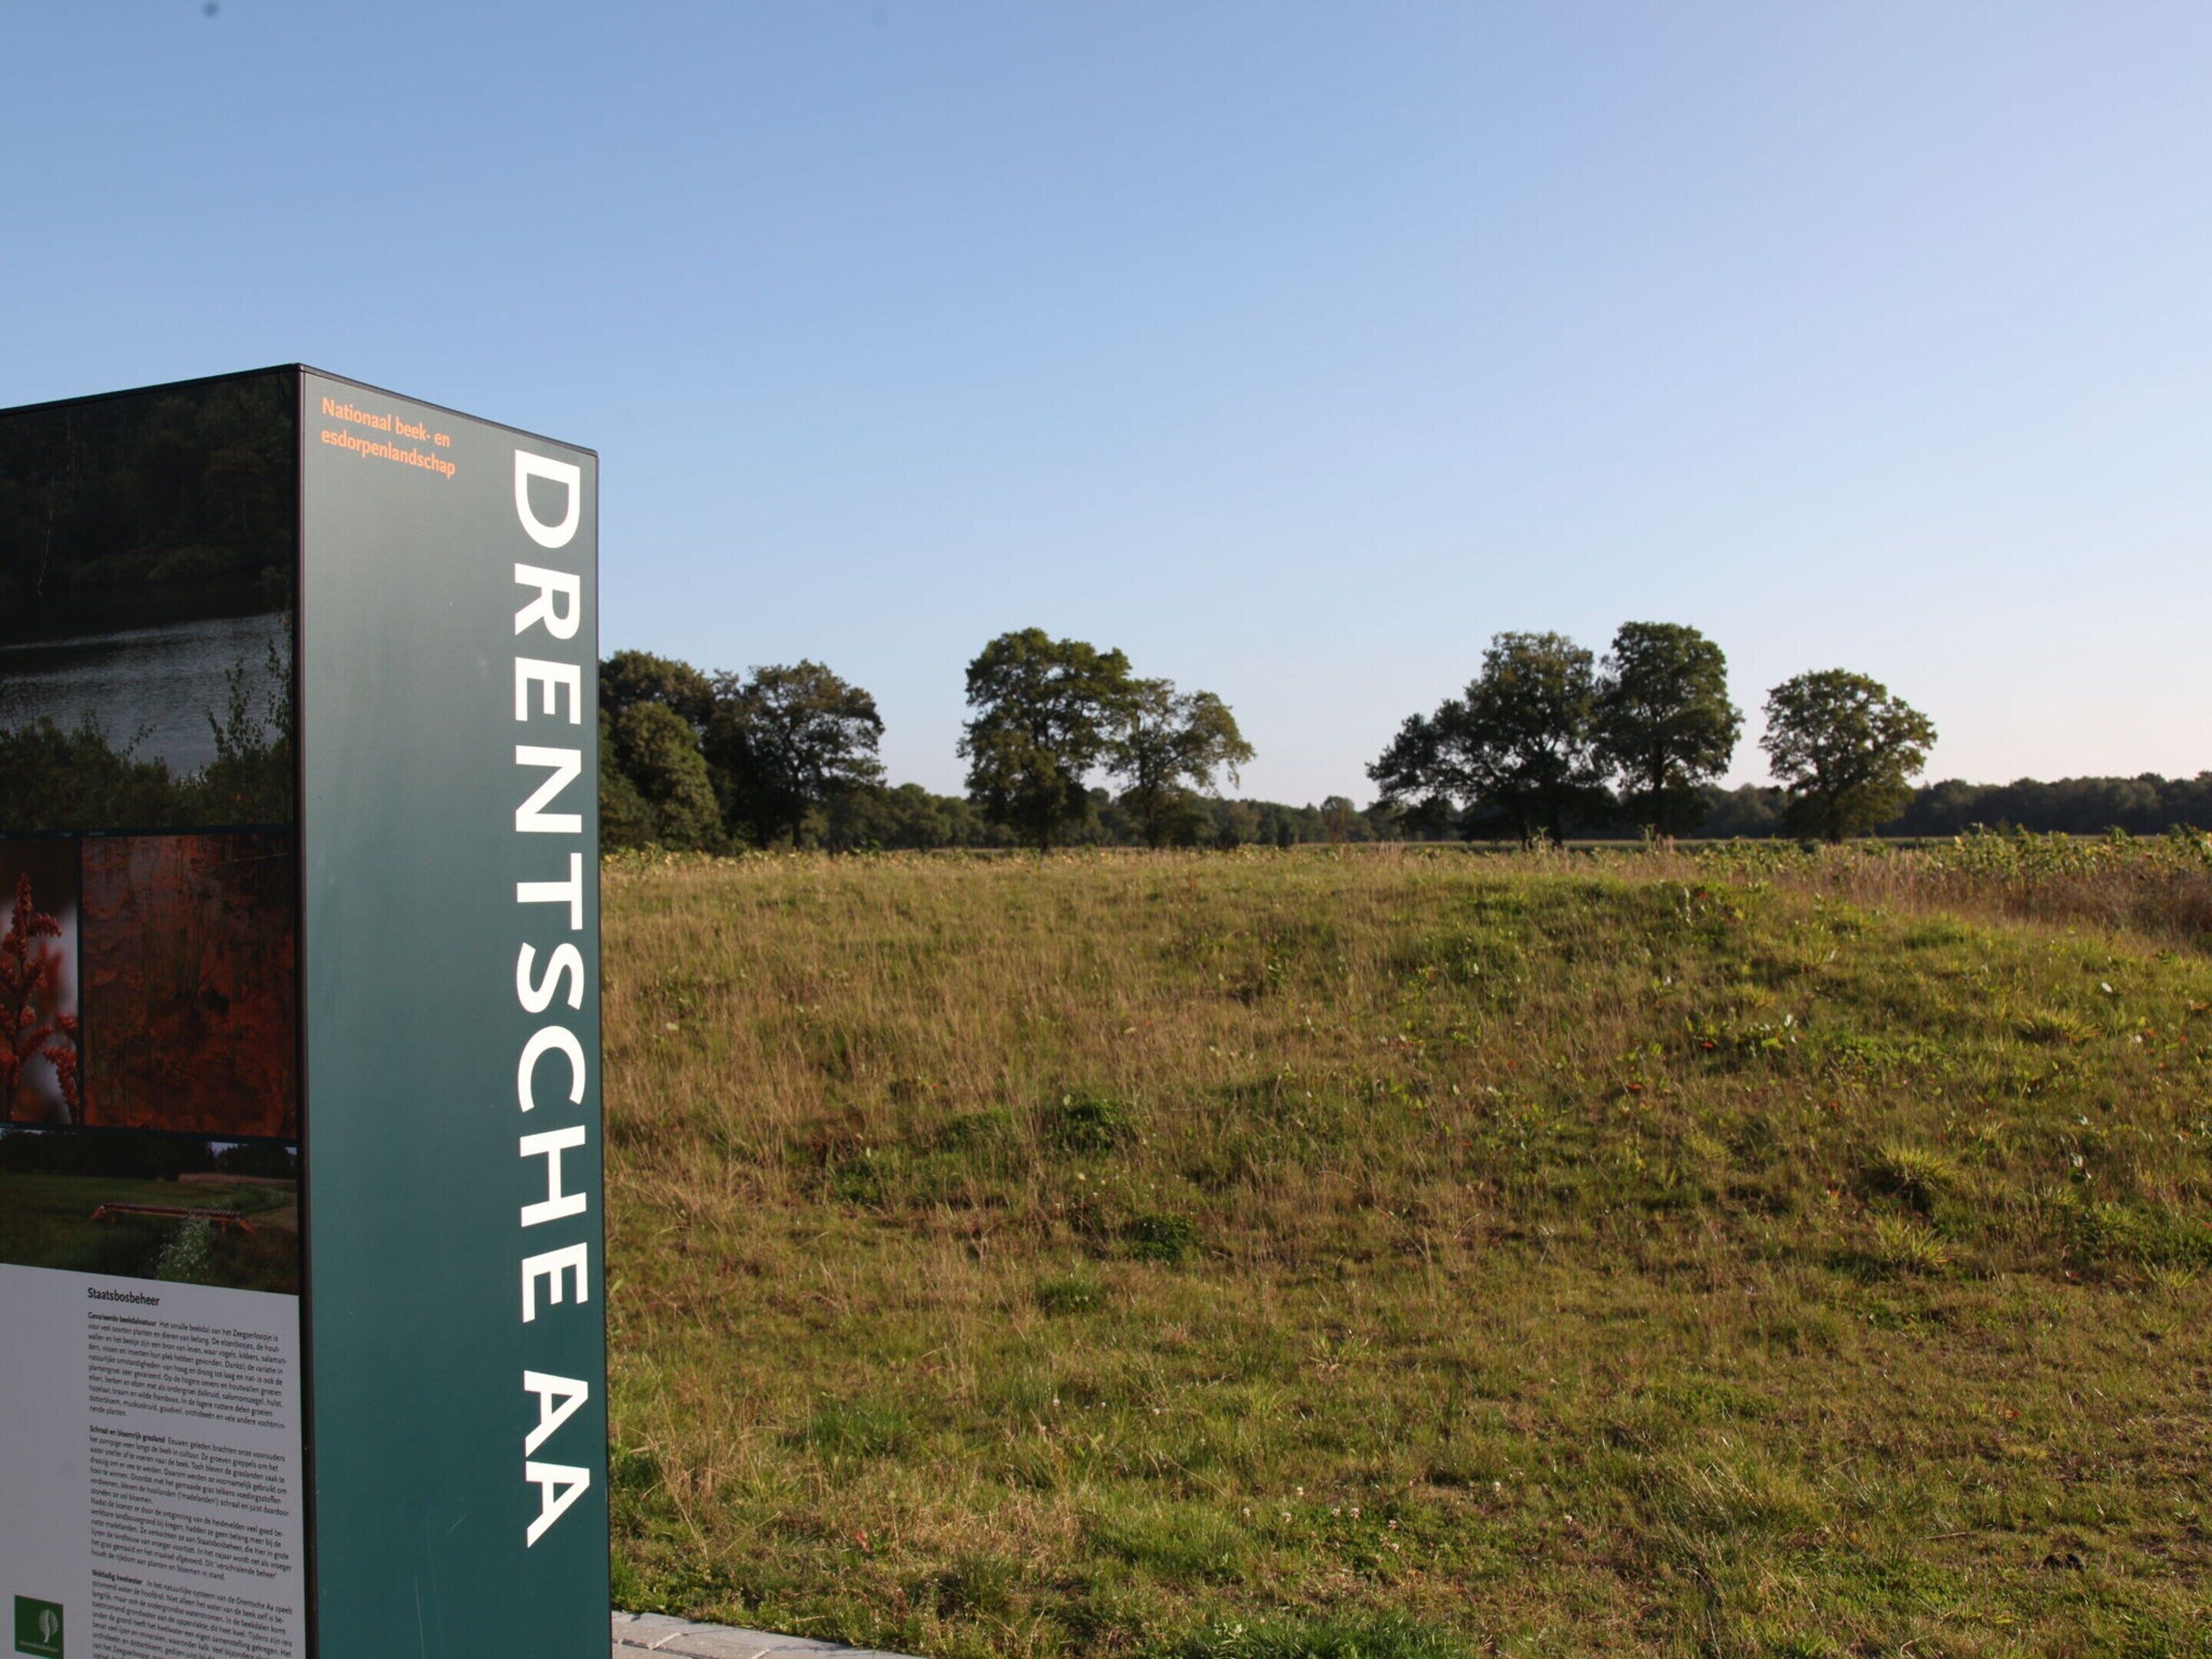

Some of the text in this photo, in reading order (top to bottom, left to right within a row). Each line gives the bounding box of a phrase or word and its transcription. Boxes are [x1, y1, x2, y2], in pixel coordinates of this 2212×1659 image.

[321, 397, 451, 448] Nationaal beek- en
[321, 429, 457, 479] esdorpenlandschap
[514, 449, 590, 1548] DRENTSCHE AA
[88, 1287, 160, 1306] Staatsbosbeheer
